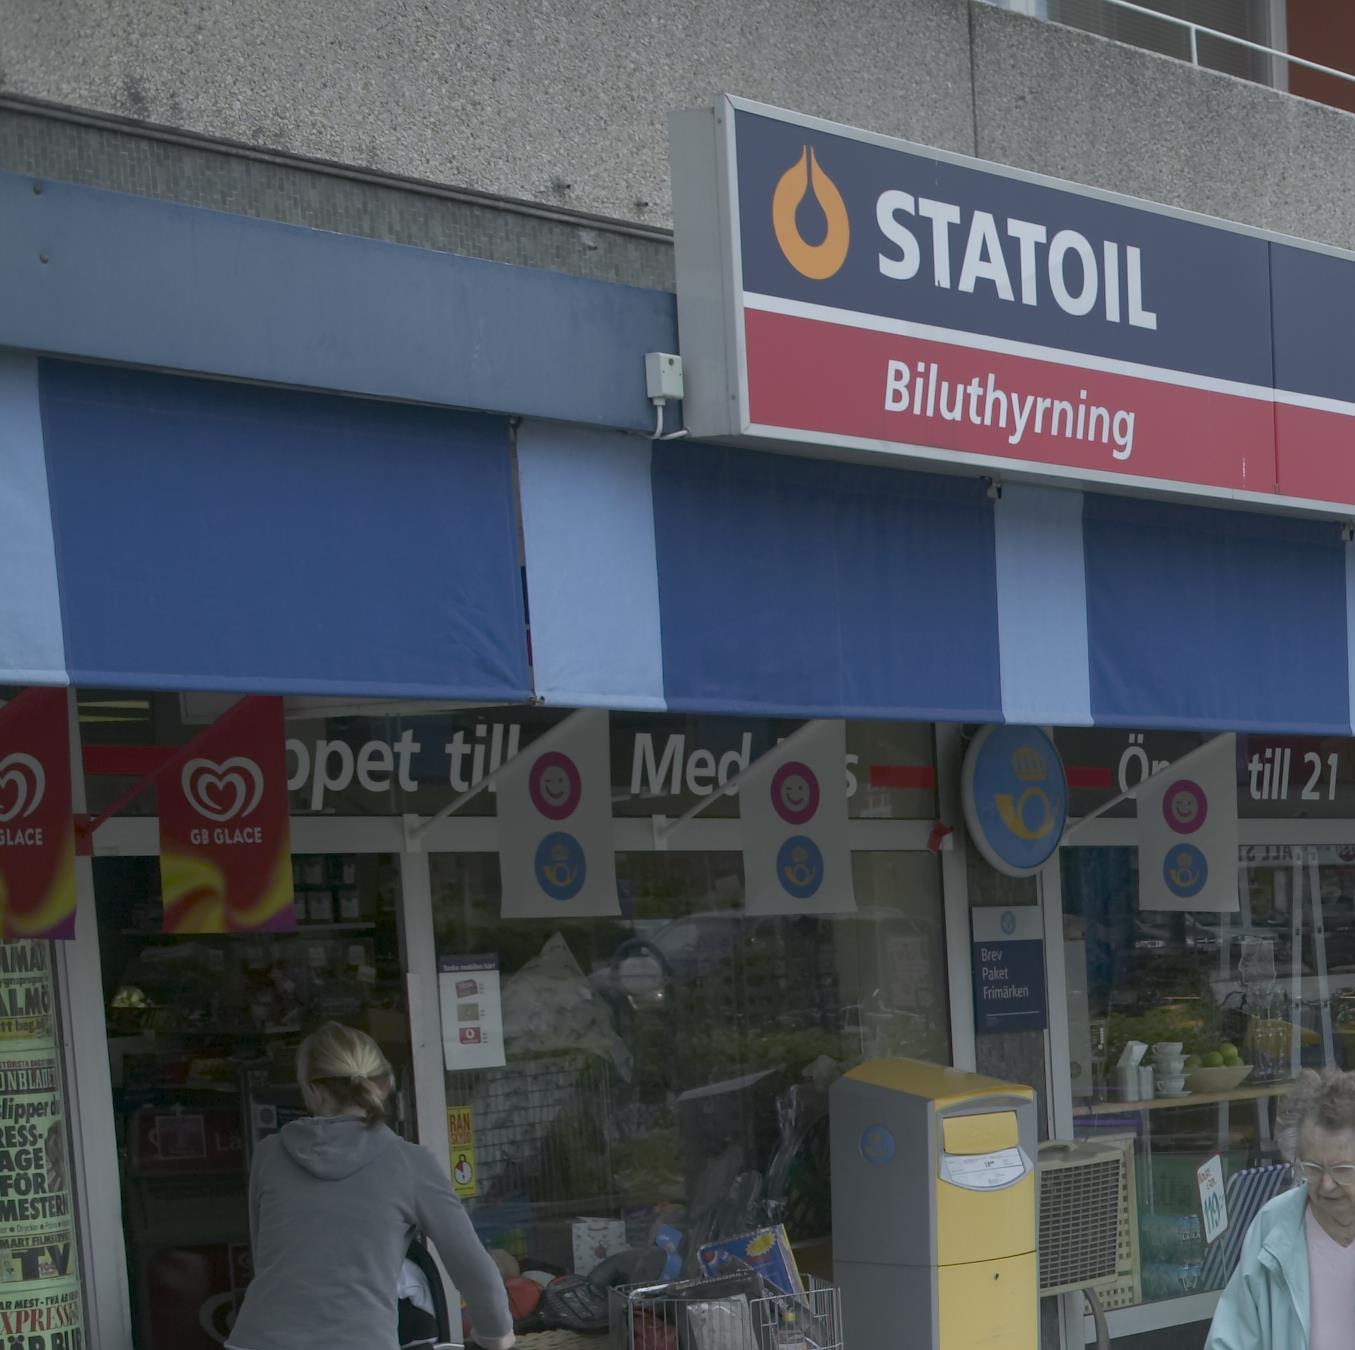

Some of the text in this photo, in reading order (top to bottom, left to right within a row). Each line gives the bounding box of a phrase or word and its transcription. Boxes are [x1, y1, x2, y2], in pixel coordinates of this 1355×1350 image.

[876, 190, 1157, 330] STATOIL
[884, 360, 1135, 460] Biluthyrning
[286, 729, 421, 811] ppet
[630, 732, 753, 796] Med
[1248, 748, 1291, 801] till
[1301, 751, 1339, 801] 21
[190, 827, 262, 845] GB GLACE
[981, 948, 1004, 963] Brev
[982, 966, 1009, 981] Paket
[983, 985, 1029, 1001] Frimärken
[0, 1097, 49, 1125] lipper
[0, 1147, 44, 1173] AGE
[0, 1193, 68, 1222] MESTERN
